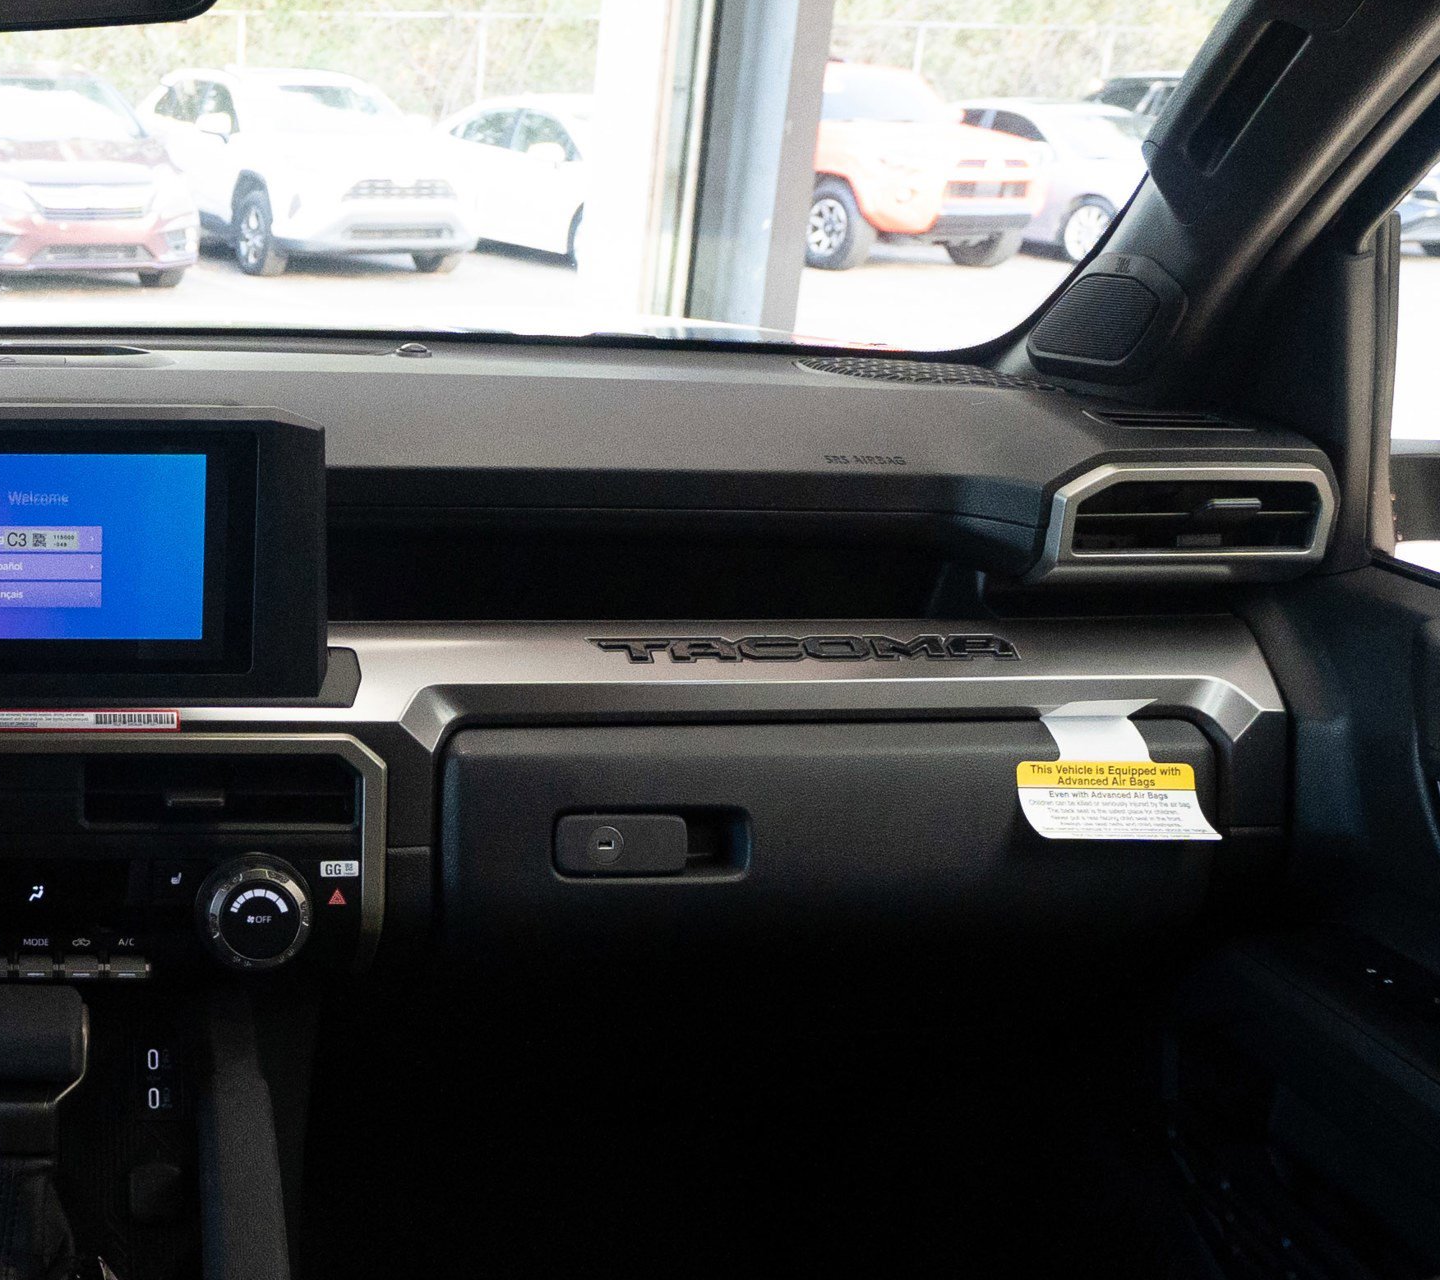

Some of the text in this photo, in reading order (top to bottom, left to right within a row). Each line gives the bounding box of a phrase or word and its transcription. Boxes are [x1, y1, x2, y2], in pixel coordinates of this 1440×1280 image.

[8, 491, 69, 506] Welcome
[7, 532, 28, 547] C3
[584, 634, 1022, 664] TACOMA
[1030, 764, 1181, 778] This Vehicle is Equipped with
[1057, 776, 1156, 788] Advanced Air Bags
[1049, 790, 1069, 798] Even
[1091, 791, 1131, 799] Advanced
[1147, 792, 1168, 800] Bags
[325, 863, 341, 875] GG
[255, 915, 272, 924] OFF
[23, 938, 49, 947] MODE
[118, 938, 135, 947] A/C
